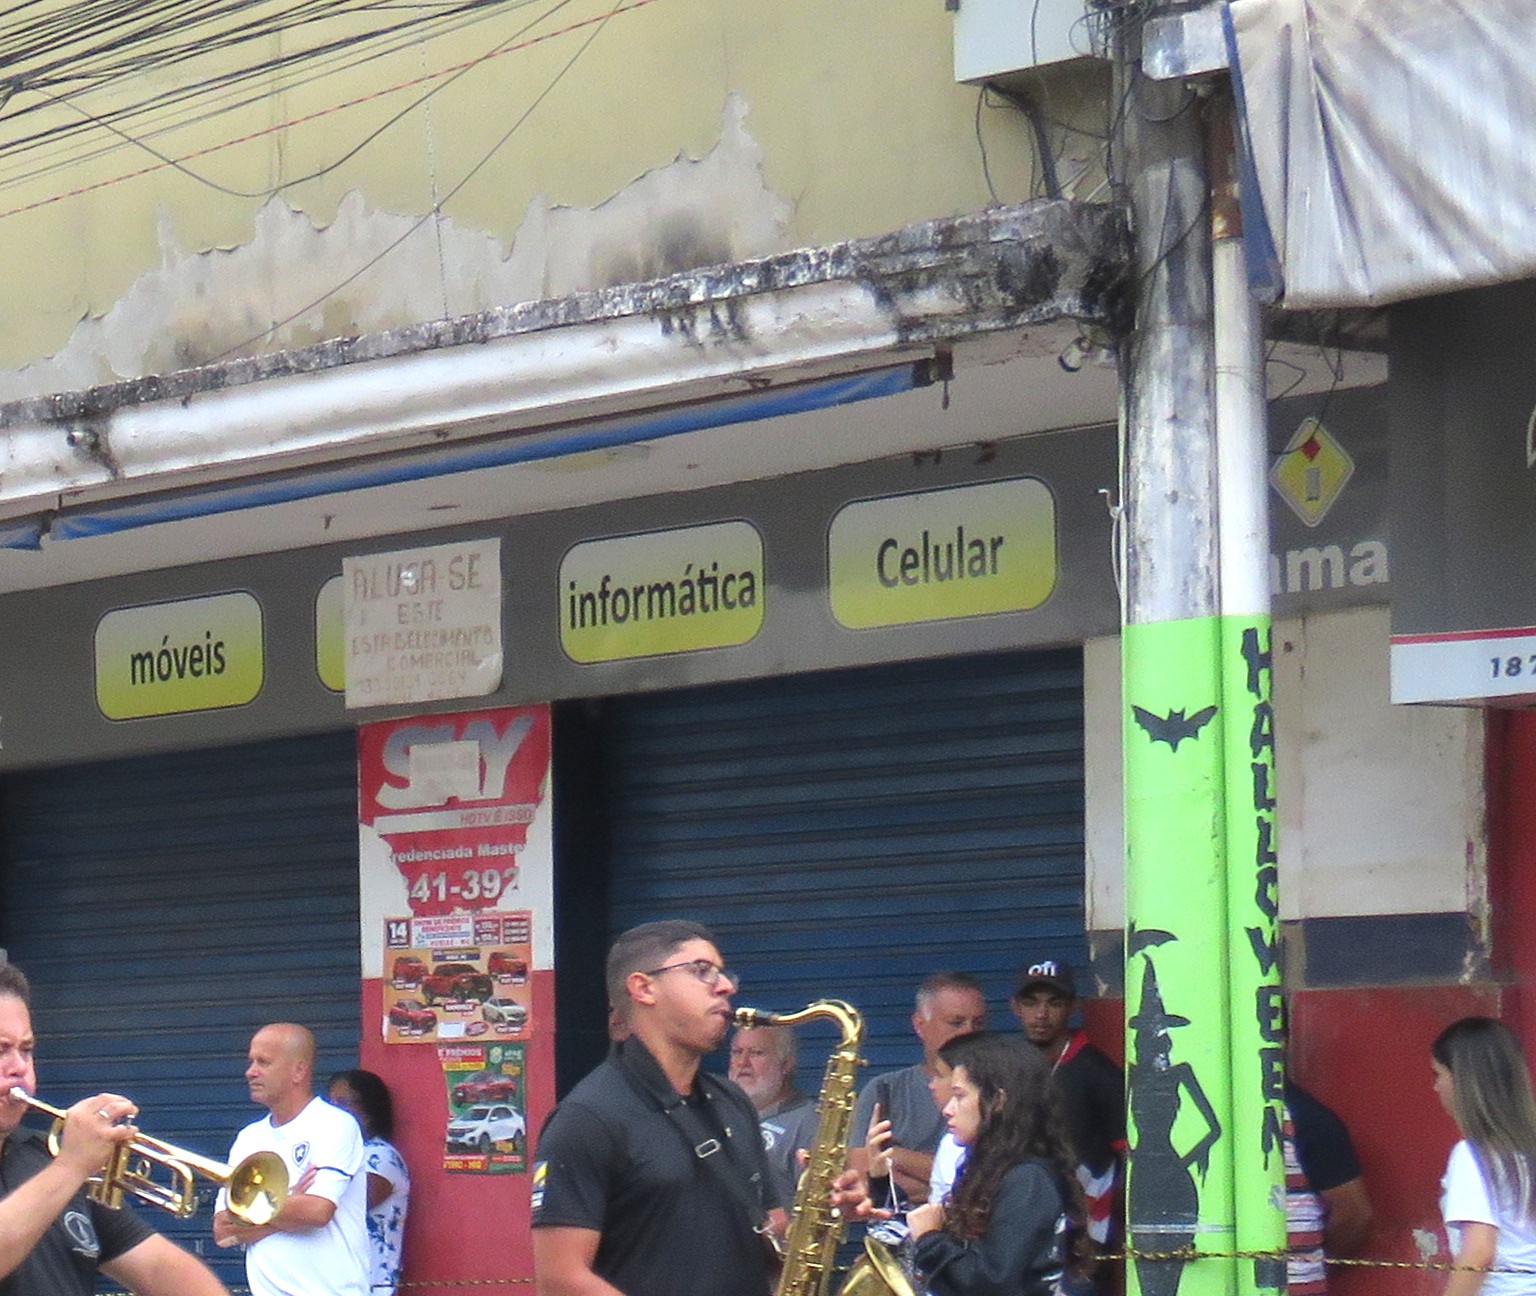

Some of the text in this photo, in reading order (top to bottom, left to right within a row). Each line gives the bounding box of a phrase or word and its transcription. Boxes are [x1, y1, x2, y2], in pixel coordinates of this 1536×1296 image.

[876, 525, 1005, 588] Celular
[1271, 540, 1389, 595] ma
[568, 562, 757, 630] informática
[130, 631, 227, 686] móveis
[459, 812, 492, 826] HDTV
[390, 847, 473, 863] redenciada
[389, 921, 408, 939] 14
